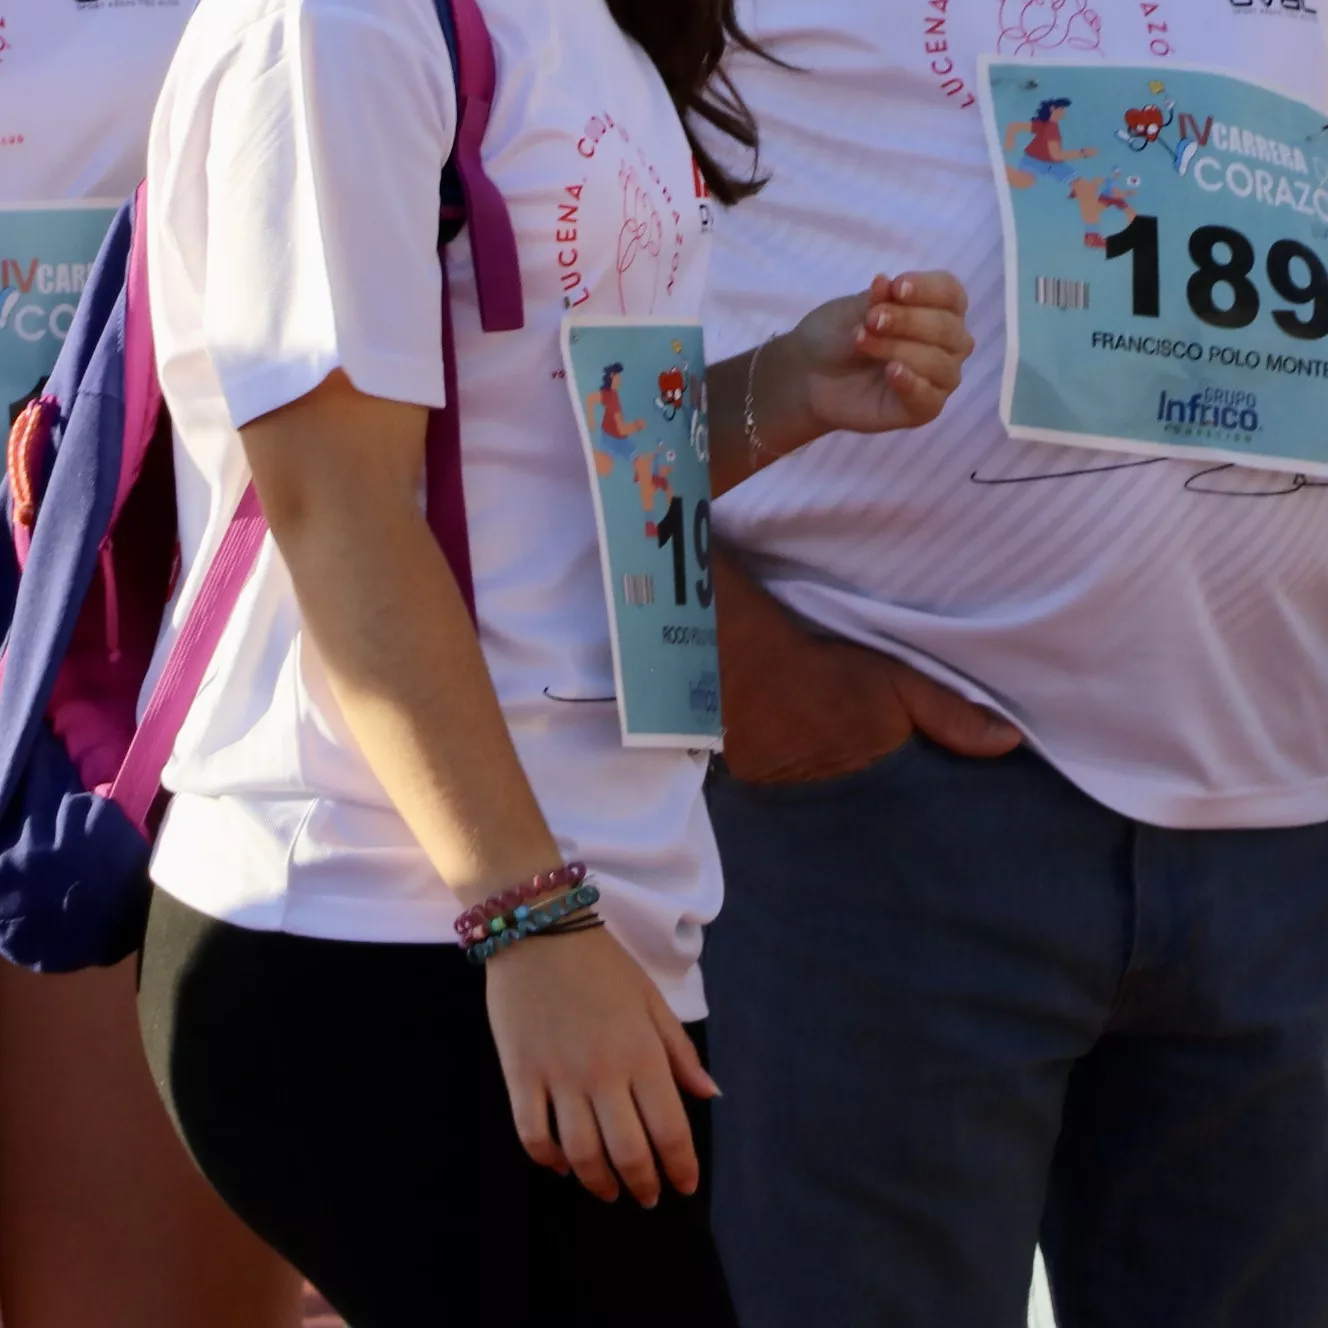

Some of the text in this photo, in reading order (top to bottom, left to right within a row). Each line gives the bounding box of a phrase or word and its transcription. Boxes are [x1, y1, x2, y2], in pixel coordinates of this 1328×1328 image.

[1178, 113, 1213, 146] IV
[1211, 123, 1309, 174] CARRERA
[1, 258, 95, 294] IV CAR
[1092, 331, 1203, 361] FRANCISCO
[1208, 345, 1260, 369] POLO
[1204, 387, 1256, 408] GRUPO
